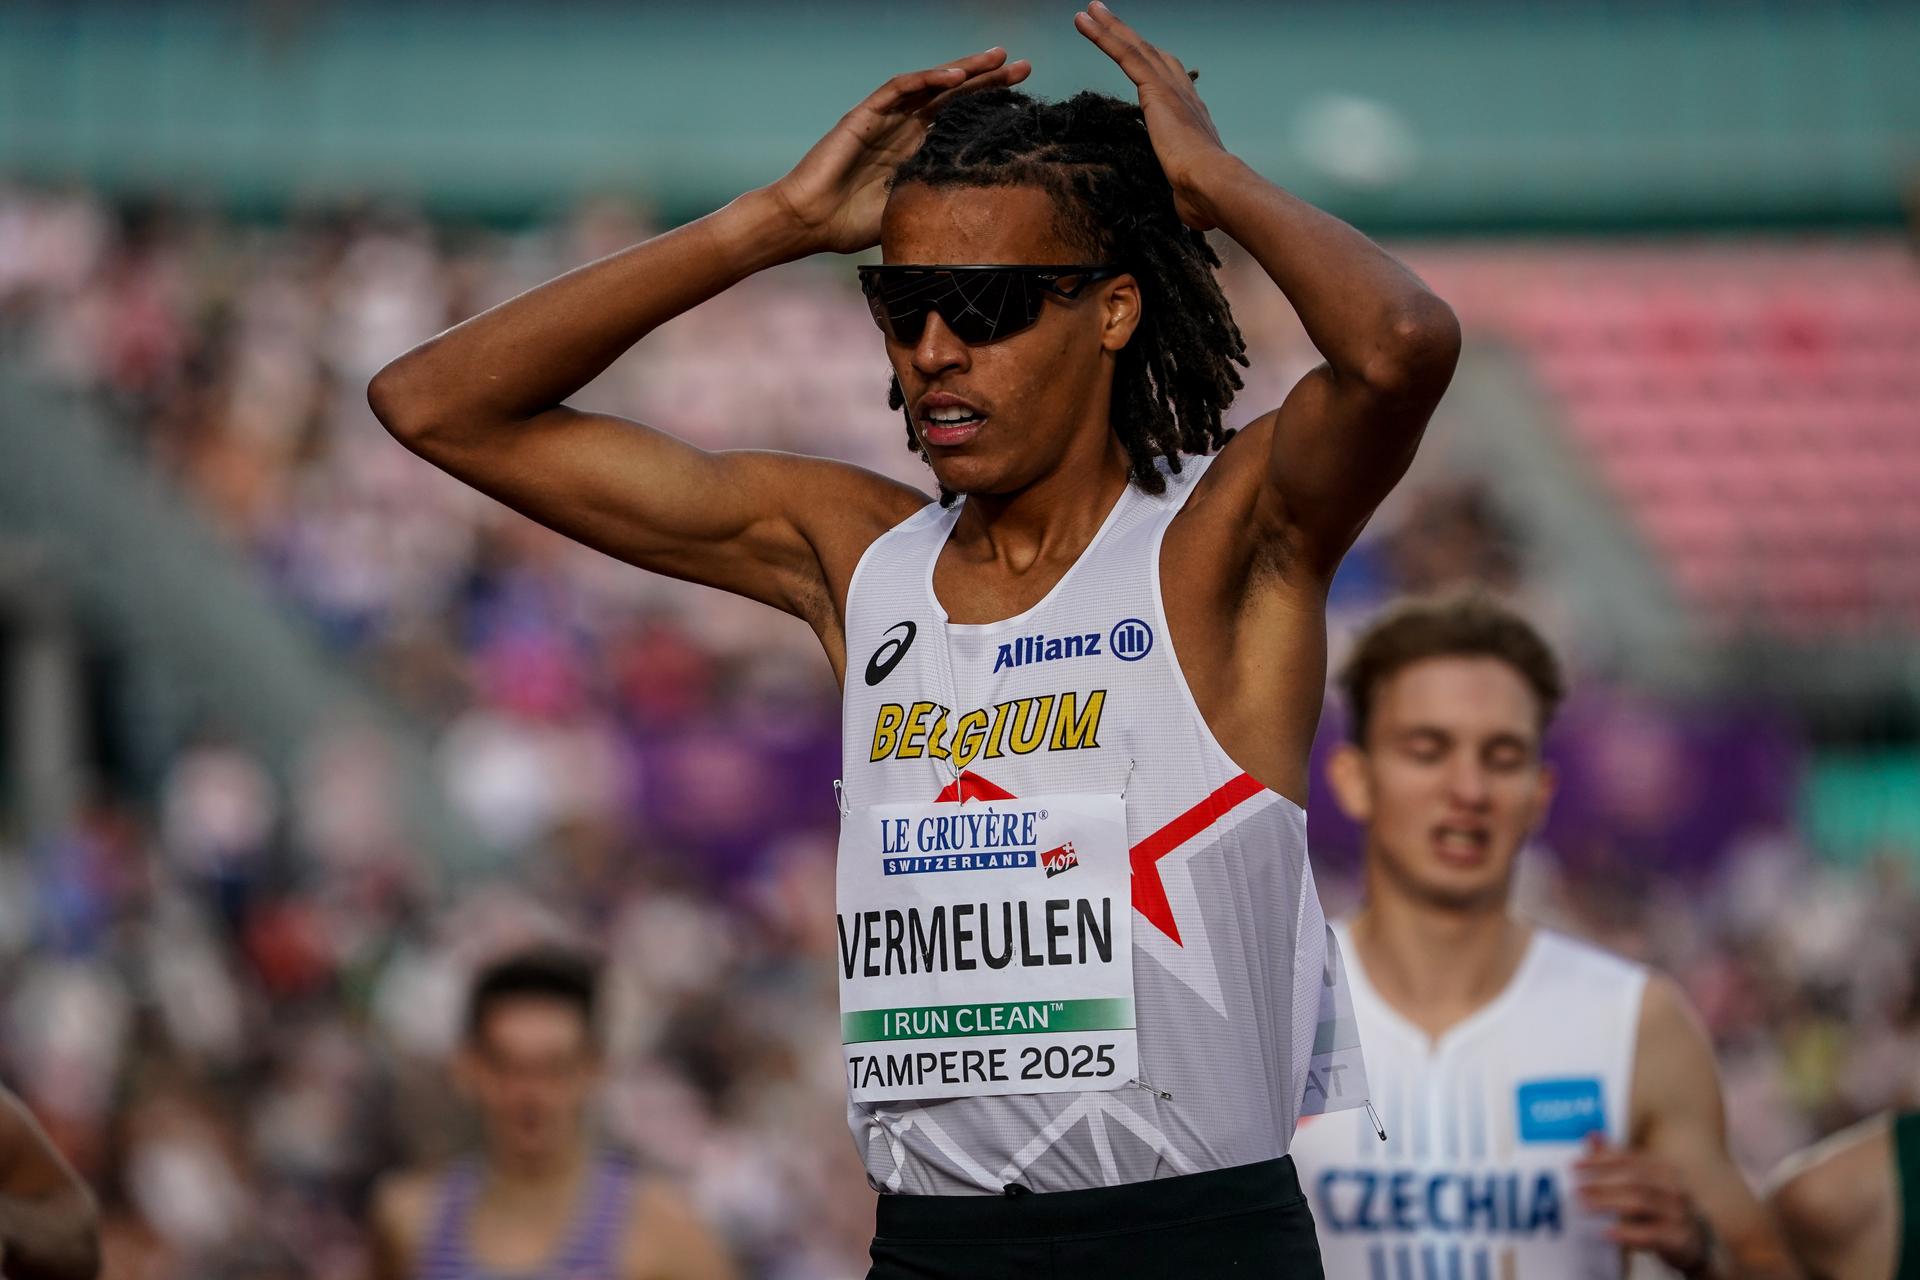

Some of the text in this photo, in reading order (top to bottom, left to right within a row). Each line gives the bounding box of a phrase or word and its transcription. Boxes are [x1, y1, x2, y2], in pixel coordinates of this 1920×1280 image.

[993, 633, 1101, 674] Allianz
[870, 689, 1107, 769] BELGIUM
[881, 818, 910, 854] LE
[888, 854, 1029, 873] SWITZERLAND
[1045, 851, 1077, 873] AOP
[837, 897, 1112, 979] VERMEULEN
[883, 1013, 889, 1036] I
[895, 1010, 949, 1035] RUN
[849, 1044, 1115, 1089] TAMPERE 2025
[1315, 1167, 1564, 1236] CZECHIA
